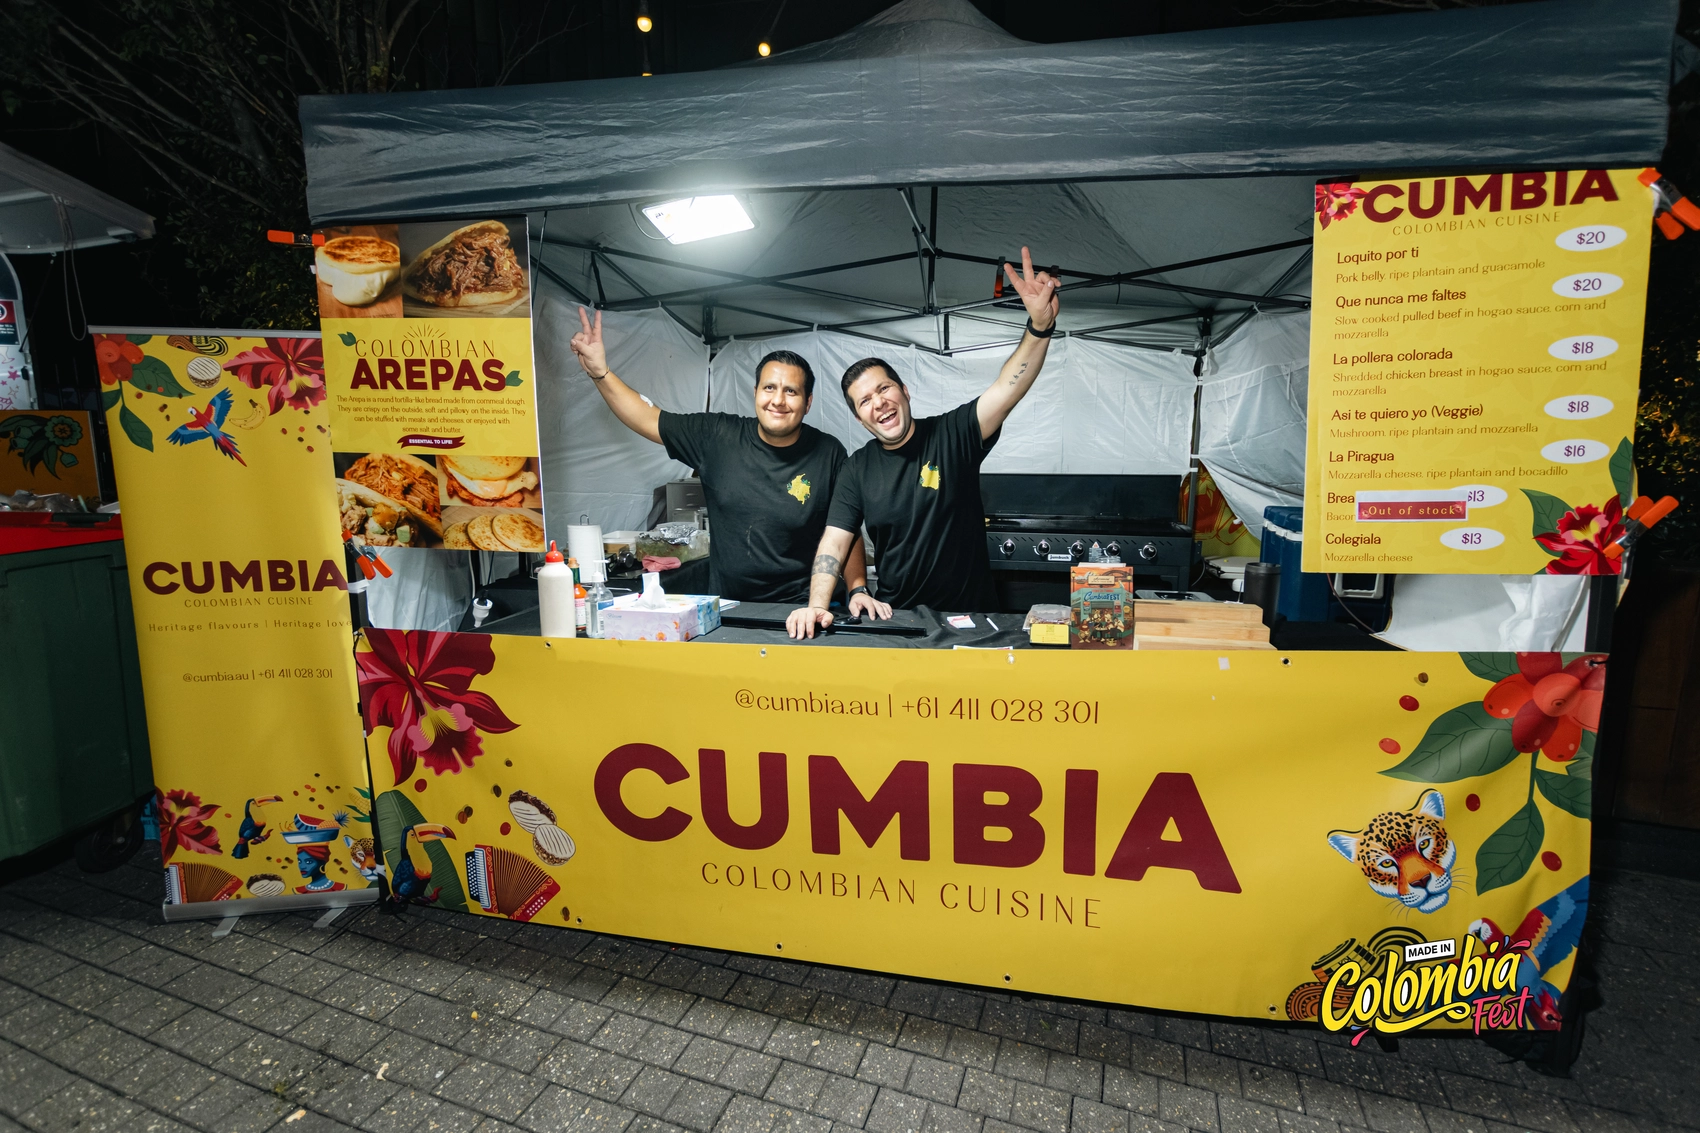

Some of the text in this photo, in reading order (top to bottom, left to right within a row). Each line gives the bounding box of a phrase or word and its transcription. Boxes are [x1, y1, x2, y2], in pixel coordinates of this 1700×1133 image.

[1362, 169, 1619, 223] CUMBIA
[1392, 211, 1561, 236] COLOMBIAN CUISINE
[1576, 231, 1605, 245] $20
[1337, 246, 1419, 264] Loquito por ti
[1336, 271, 1358, 283] Pork
[1389, 268, 1409, 280] ripe
[1412, 264, 1455, 280] plantain
[1458, 263, 1479, 274] and
[1482, 258, 1545, 274] guacamole
[1572, 278, 1602, 292] $20
[1335, 288, 1466, 309] Que nunca me faltes
[1335, 314, 1358, 326] Slow
[1362, 311, 1399, 324] cooked
[1402, 309, 1435, 323] pulled
[1438, 308, 1462, 319] beef
[1464, 308, 1474, 317] in
[1477, 305, 1512, 319] hogao
[1555, 302, 1581, 312] corn
[1584, 300, 1606, 310] and
[1334, 328, 1389, 340] mozzarella
[355, 339, 495, 358] COLOMBIAN
[1572, 341, 1594, 355] $18
[1333, 348, 1452, 366] La pollera colorada
[350, 359, 506, 391] AREPAS
[1333, 370, 1383, 382] Shredded
[1386, 367, 1427, 380] chicken
[1429, 366, 1462, 378] breast
[1466, 366, 1476, 376] in
[1479, 364, 1514, 378] hogao
[1556, 362, 1581, 372] corn
[1585, 361, 1607, 371] and
[1332, 386, 1386, 397] mozzarella
[338, 405, 351, 413] They
[450, 407, 469, 415] pillowy
[512, 408, 526, 416] They
[1331, 404, 1483, 421] Asi te quiero yo (Veggie)
[1567, 400, 1589, 414] $18
[1389, 426, 1408, 438] ripe
[1412, 424, 1454, 436] plantain
[1457, 424, 1477, 435] and
[1480, 423, 1538, 434] mozzarella
[1329, 450, 1394, 464] La Piragua
[1564, 444, 1586, 458] $16
[1328, 469, 1382, 479] Mozzarella
[1426, 469, 1446, 480] ripe
[1449, 467, 1492, 479] plantain
[1495, 466, 1516, 476] and
[1518, 466, 1568, 476] bocadillo
[1368, 506, 1455, 515] Out of stock
[1325, 532, 1381, 546] Colegiala
[1461, 532, 1481, 545] $13
[1325, 553, 1412, 562] Mozzarella cheese
[143, 560, 348, 595] CUMBIA
[184, 597, 313, 607] COLOMBIAN CUISINE
[148, 623, 203, 632] Heritage
[209, 621, 259, 630] flavours
[274, 620, 321, 629] Heritage
[183, 672, 249, 682] @cumbia.au
[259, 669, 275, 679] +61
[278, 669, 291, 678] 411
[294, 669, 313, 678] 028
[316, 669, 333, 678] 301
[735, 689, 878, 716] @cumbia.au
[902, 696, 938, 719] +61
[949, 698, 979, 720] 411
[991, 699, 1043, 722] 028
[1054, 700, 1098, 724] 301
[594, 743, 1242, 894] CUMBIA
[702, 862, 1102, 928] COLOMBIAN CUISINE
